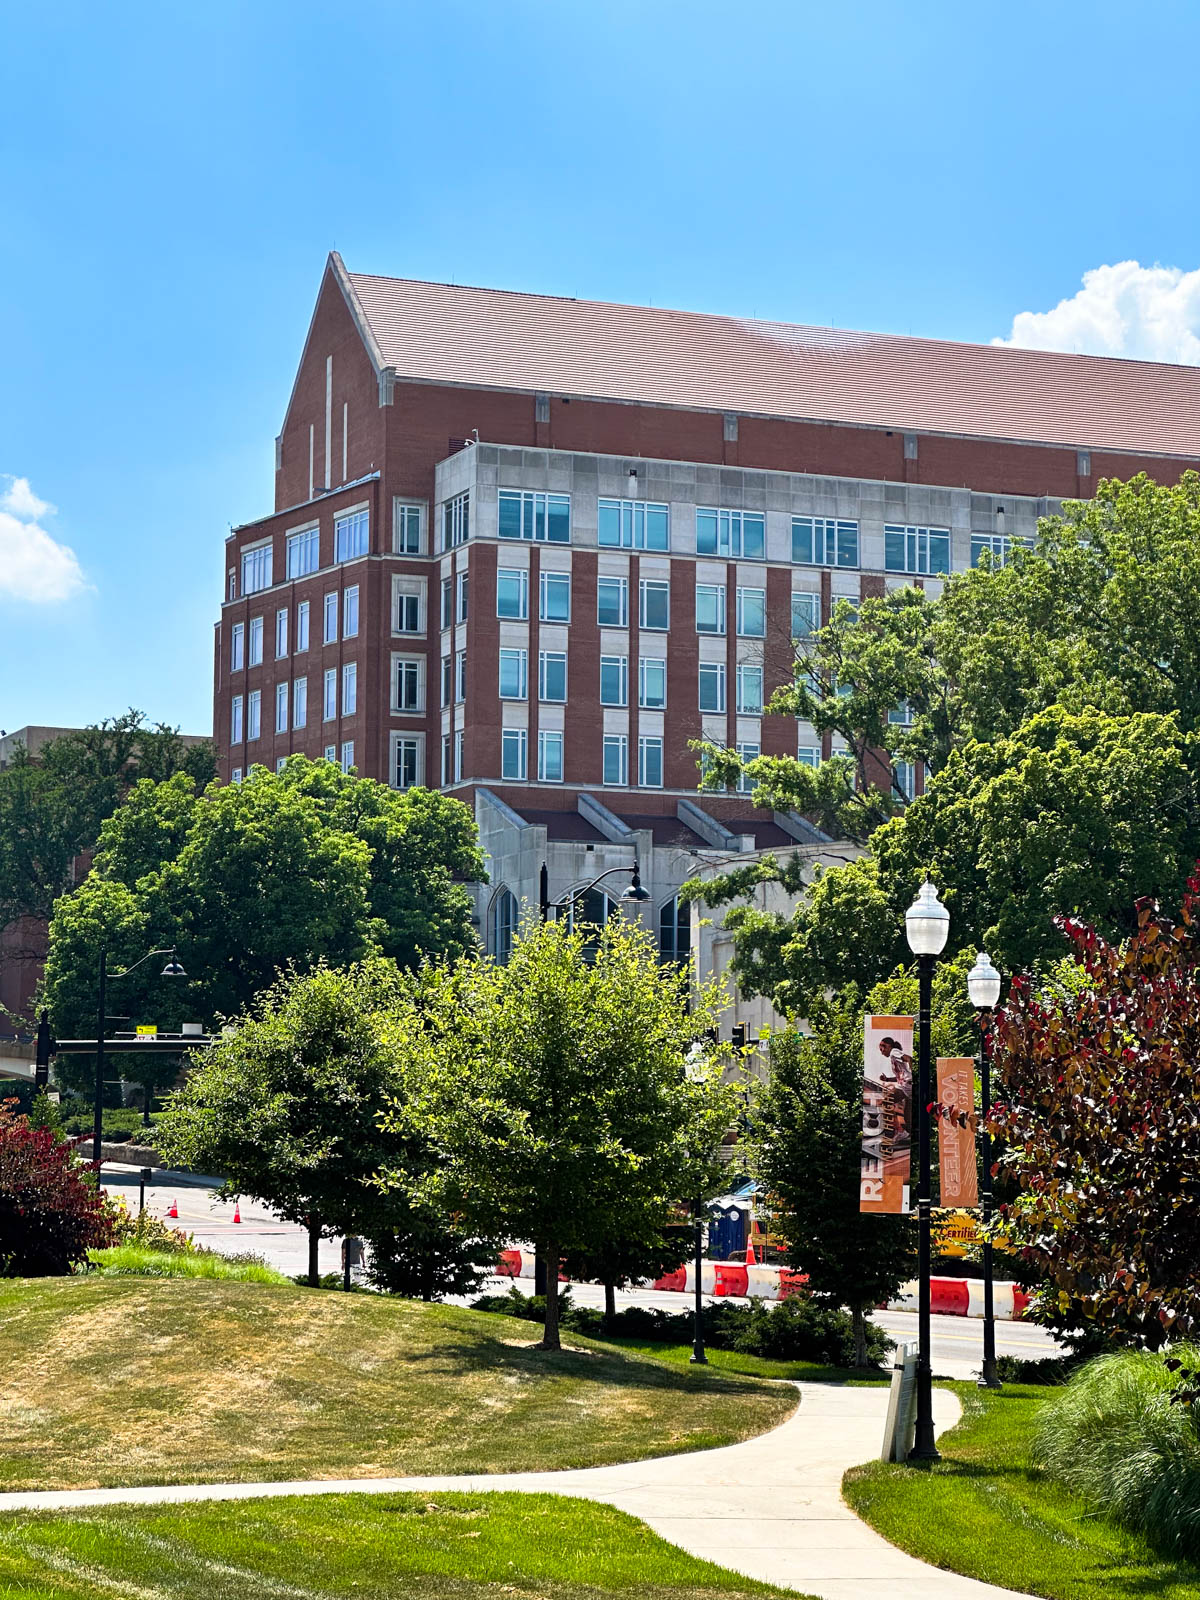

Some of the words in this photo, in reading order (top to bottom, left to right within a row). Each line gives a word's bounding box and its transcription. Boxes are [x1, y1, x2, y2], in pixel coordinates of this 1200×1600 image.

[958, 1070, 968, 1078] IT
[959, 1081, 968, 1105] TAKES
[860, 1092, 884, 1201] REACH
[942, 1073, 961, 1197] VONTEER
[880, 1137, 894, 1162] NEW
